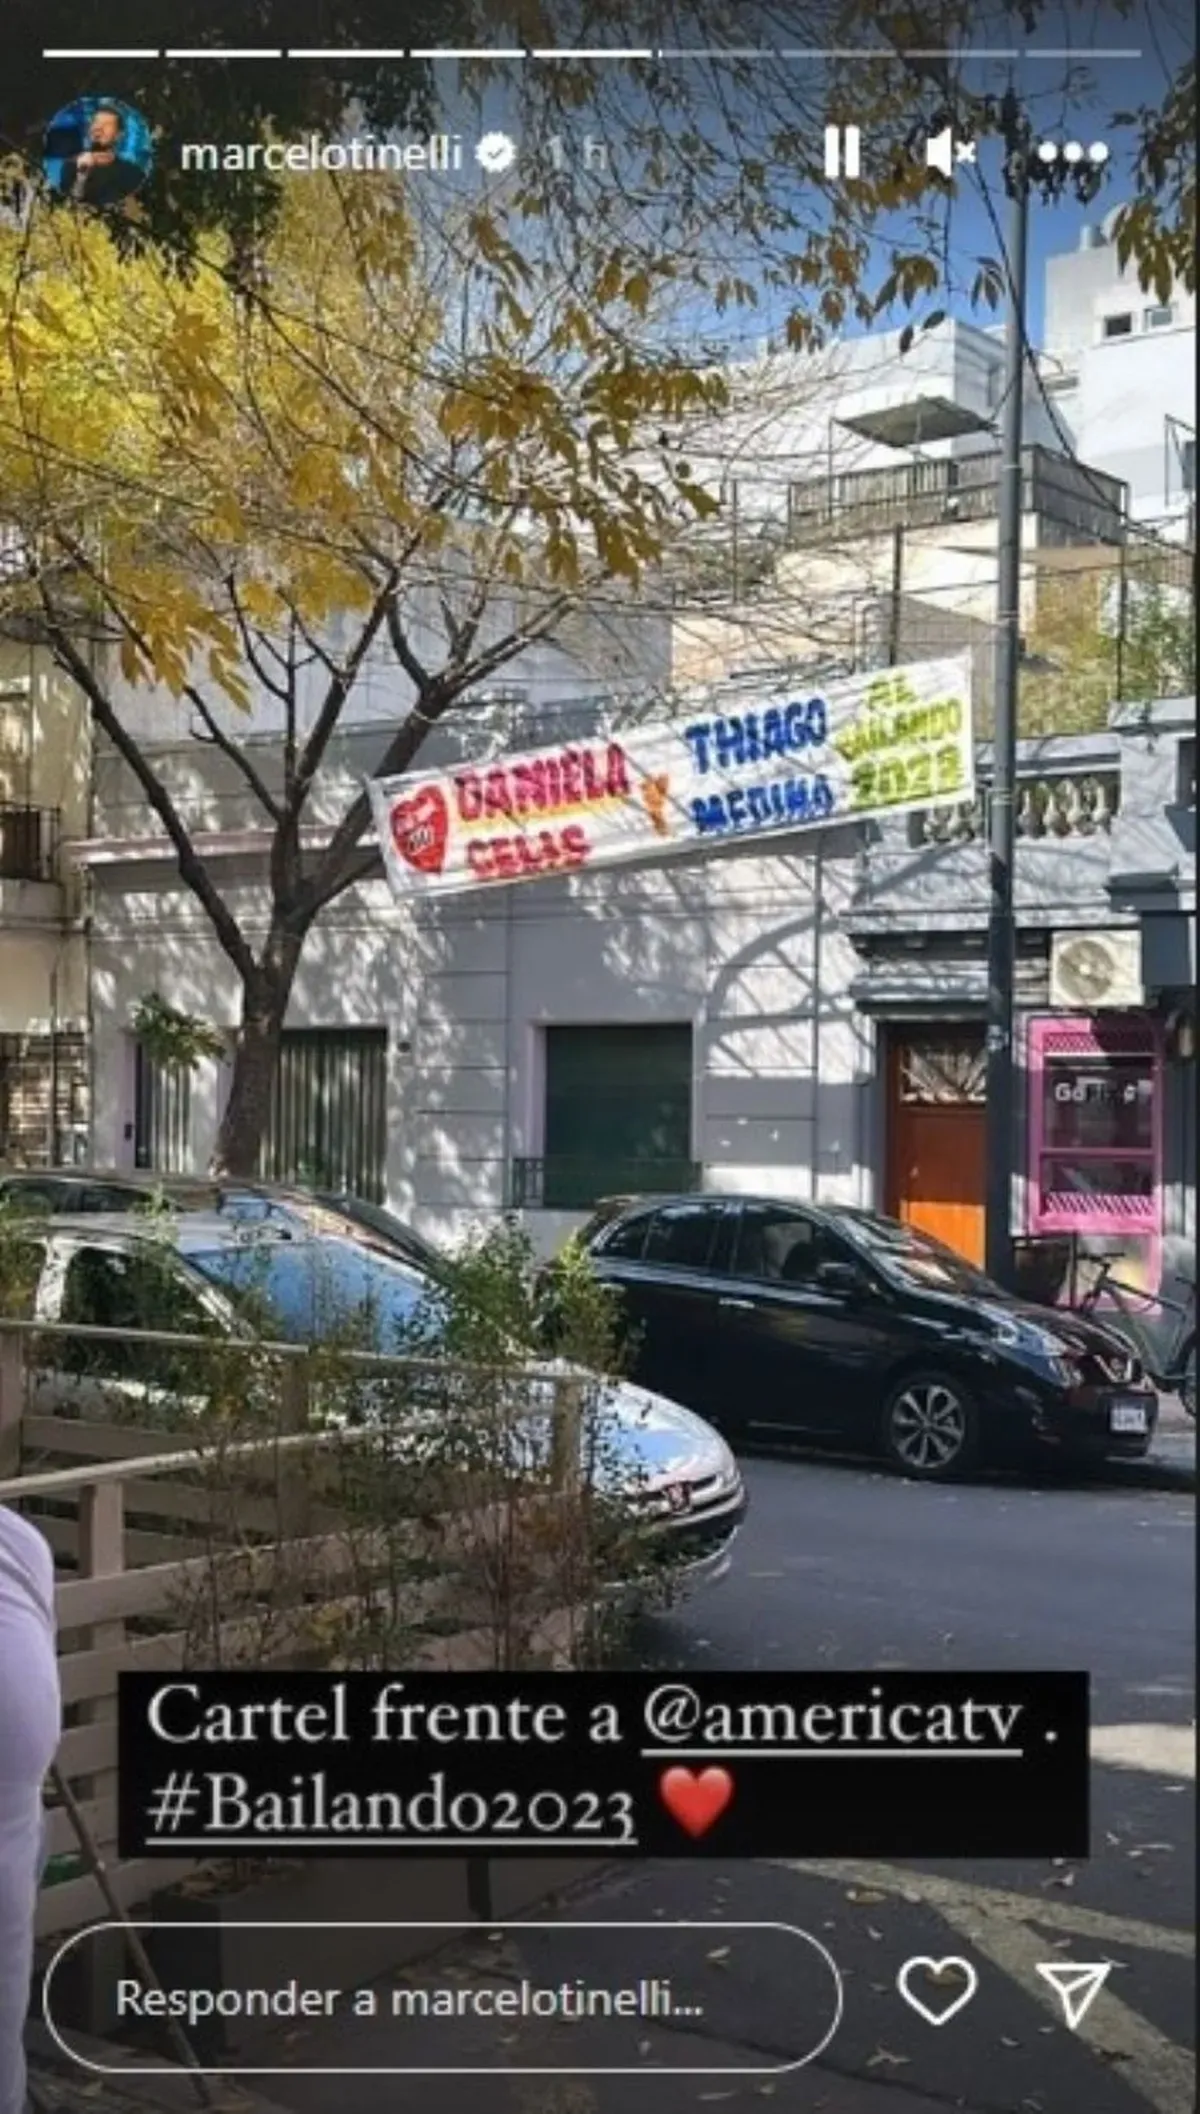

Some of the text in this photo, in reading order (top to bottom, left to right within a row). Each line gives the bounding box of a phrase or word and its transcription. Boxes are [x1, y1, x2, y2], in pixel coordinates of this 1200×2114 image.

[685, 698, 827, 774] THIAGO
[455, 742, 630, 822] DANIELA
[691, 773, 834, 835] MEDINA
